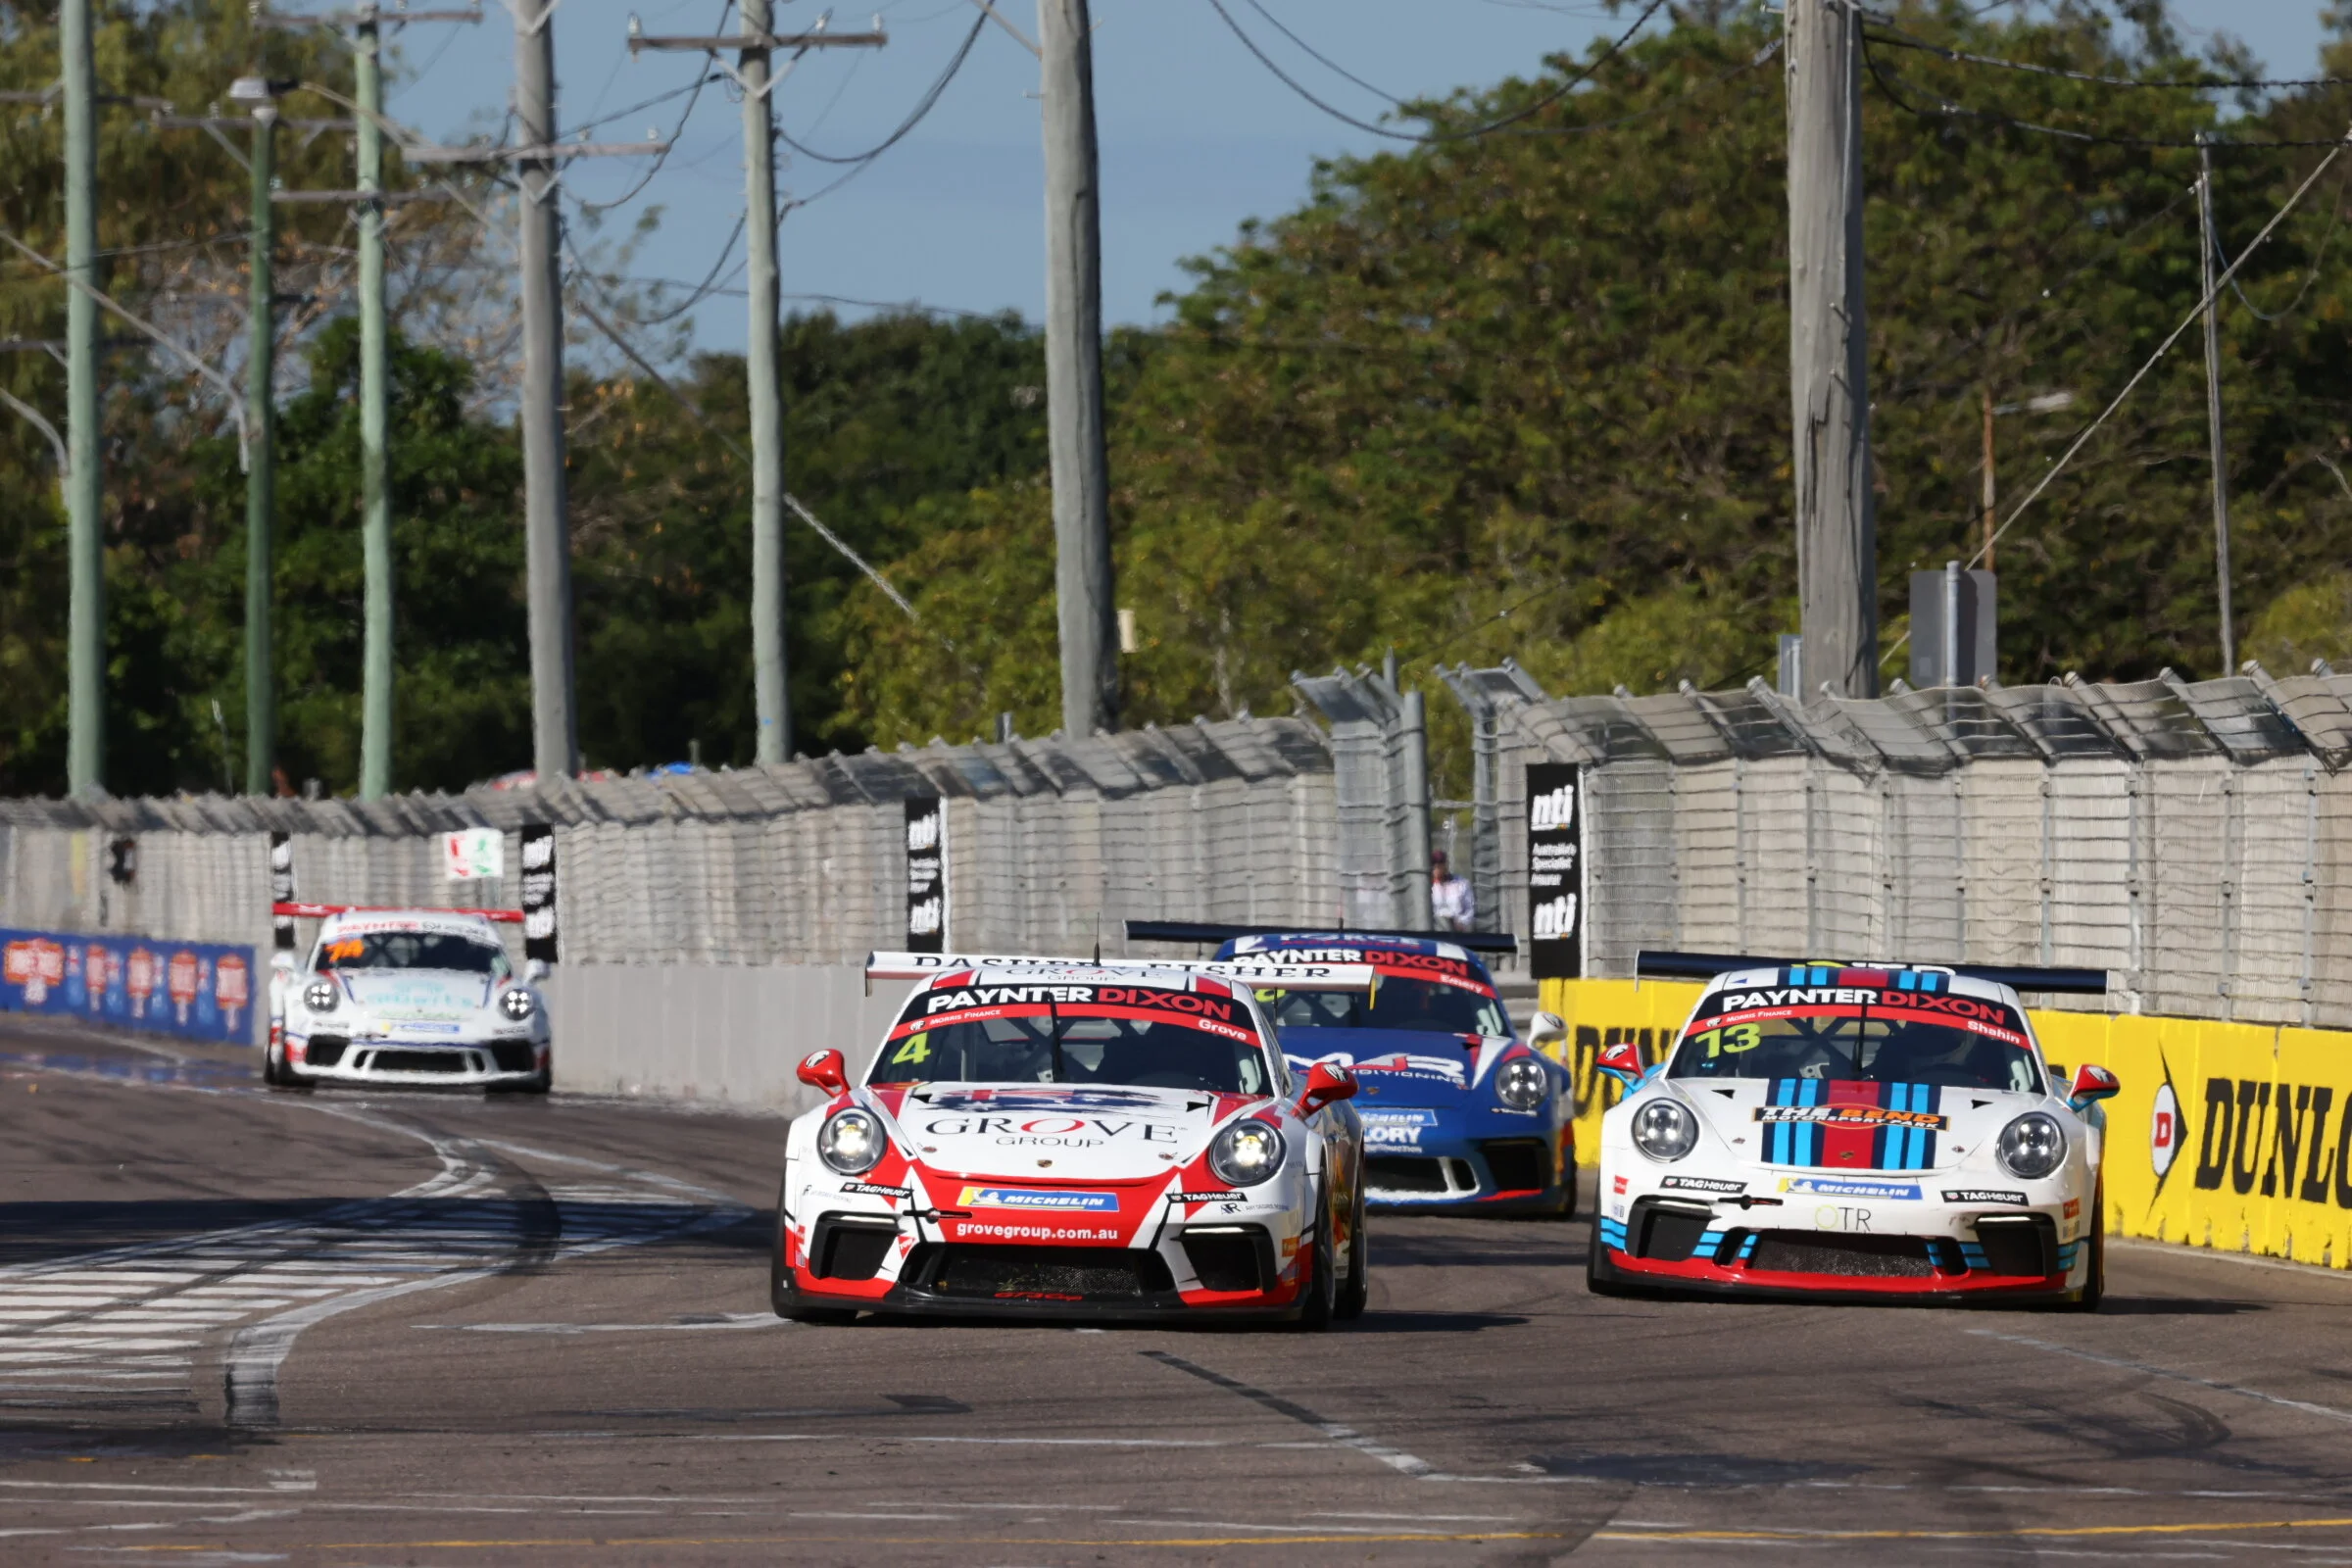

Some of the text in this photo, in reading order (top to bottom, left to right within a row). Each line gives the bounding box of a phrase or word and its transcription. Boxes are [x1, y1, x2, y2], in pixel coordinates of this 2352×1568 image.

[1532, 785, 1574, 824] nti
[1534, 893, 1577, 933] nti
[1364, 950, 1468, 977] DIXON
[1440, 974, 1485, 994] Emery
[927, 986, 1093, 1014] PAYNTER
[1098, 987, 1231, 1021] DIXON
[1723, 988, 2006, 1025] PAYNTER DIXON
[929, 1015, 962, 1026] MORRIS
[964, 1009, 1002, 1019] FINANCE
[1726, 1013, 1756, 1023] MORRIS
[1757, 1009, 1792, 1018] FINANCE
[1199, 1018, 1247, 1041] Grove
[1694, 1023, 1761, 1058] 13
[1967, 1020, 2021, 1045] Shahin
[892, 1032, 931, 1064] 4
[1761, 1114, 1939, 1128] MOTORSPORT PARK
[1762, 1106, 1940, 1124] THE BEND
[925, 1117, 1178, 1144] GROVE
[996, 1136, 1104, 1148] GROUP
[1004, 1196, 1105, 1206] MICHELIN
[1817, 1184, 1910, 1197] MICHELIN
[1814, 1203, 1872, 1232] OTR
[956, 1222, 1118, 1240] grovegroup.com.au
